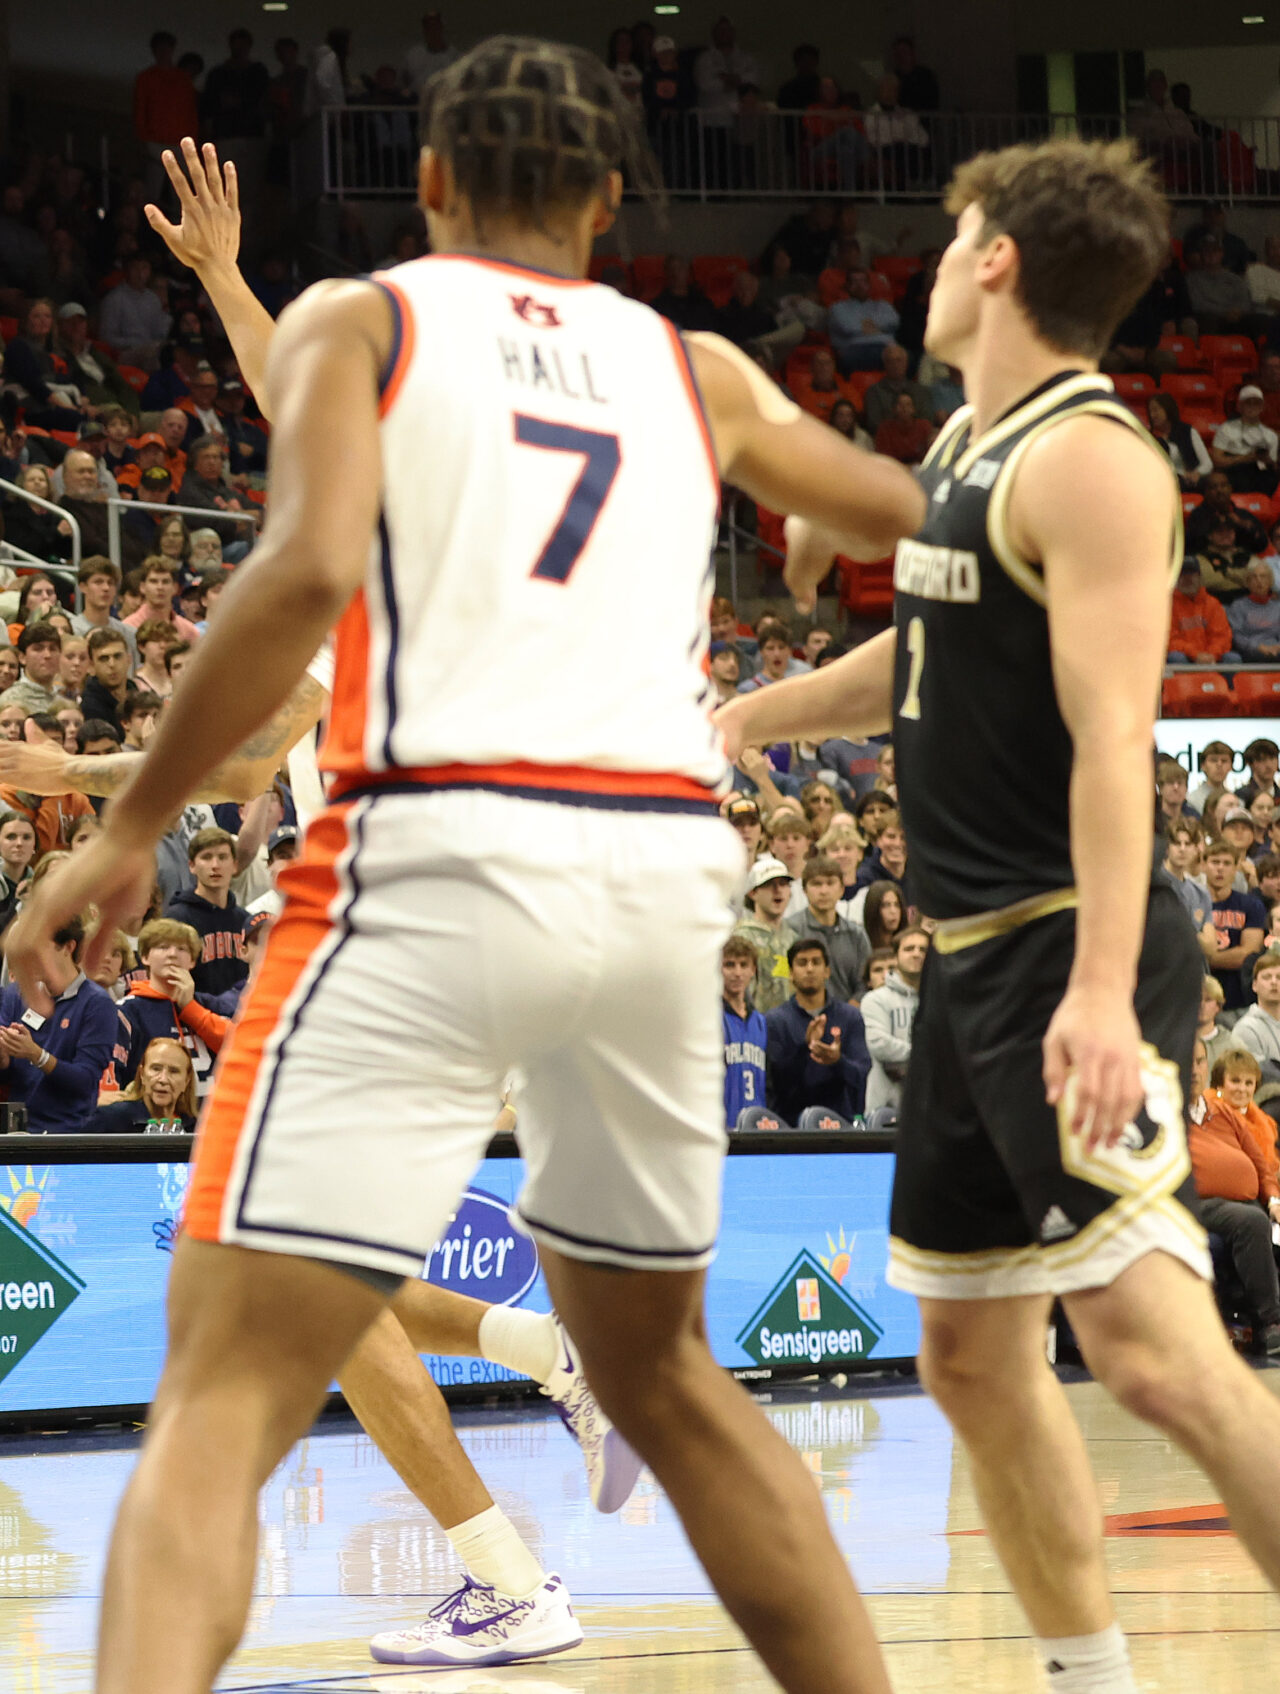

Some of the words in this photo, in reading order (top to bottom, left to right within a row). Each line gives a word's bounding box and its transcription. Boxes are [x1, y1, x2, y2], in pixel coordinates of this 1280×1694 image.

[497, 336, 609, 405] HALL
[512, 411, 622, 585] 7
[742, 1070, 755, 1101] 3
[421, 1224, 515, 1281] rrier
[760, 1325, 864, 1364] Sensigreen
